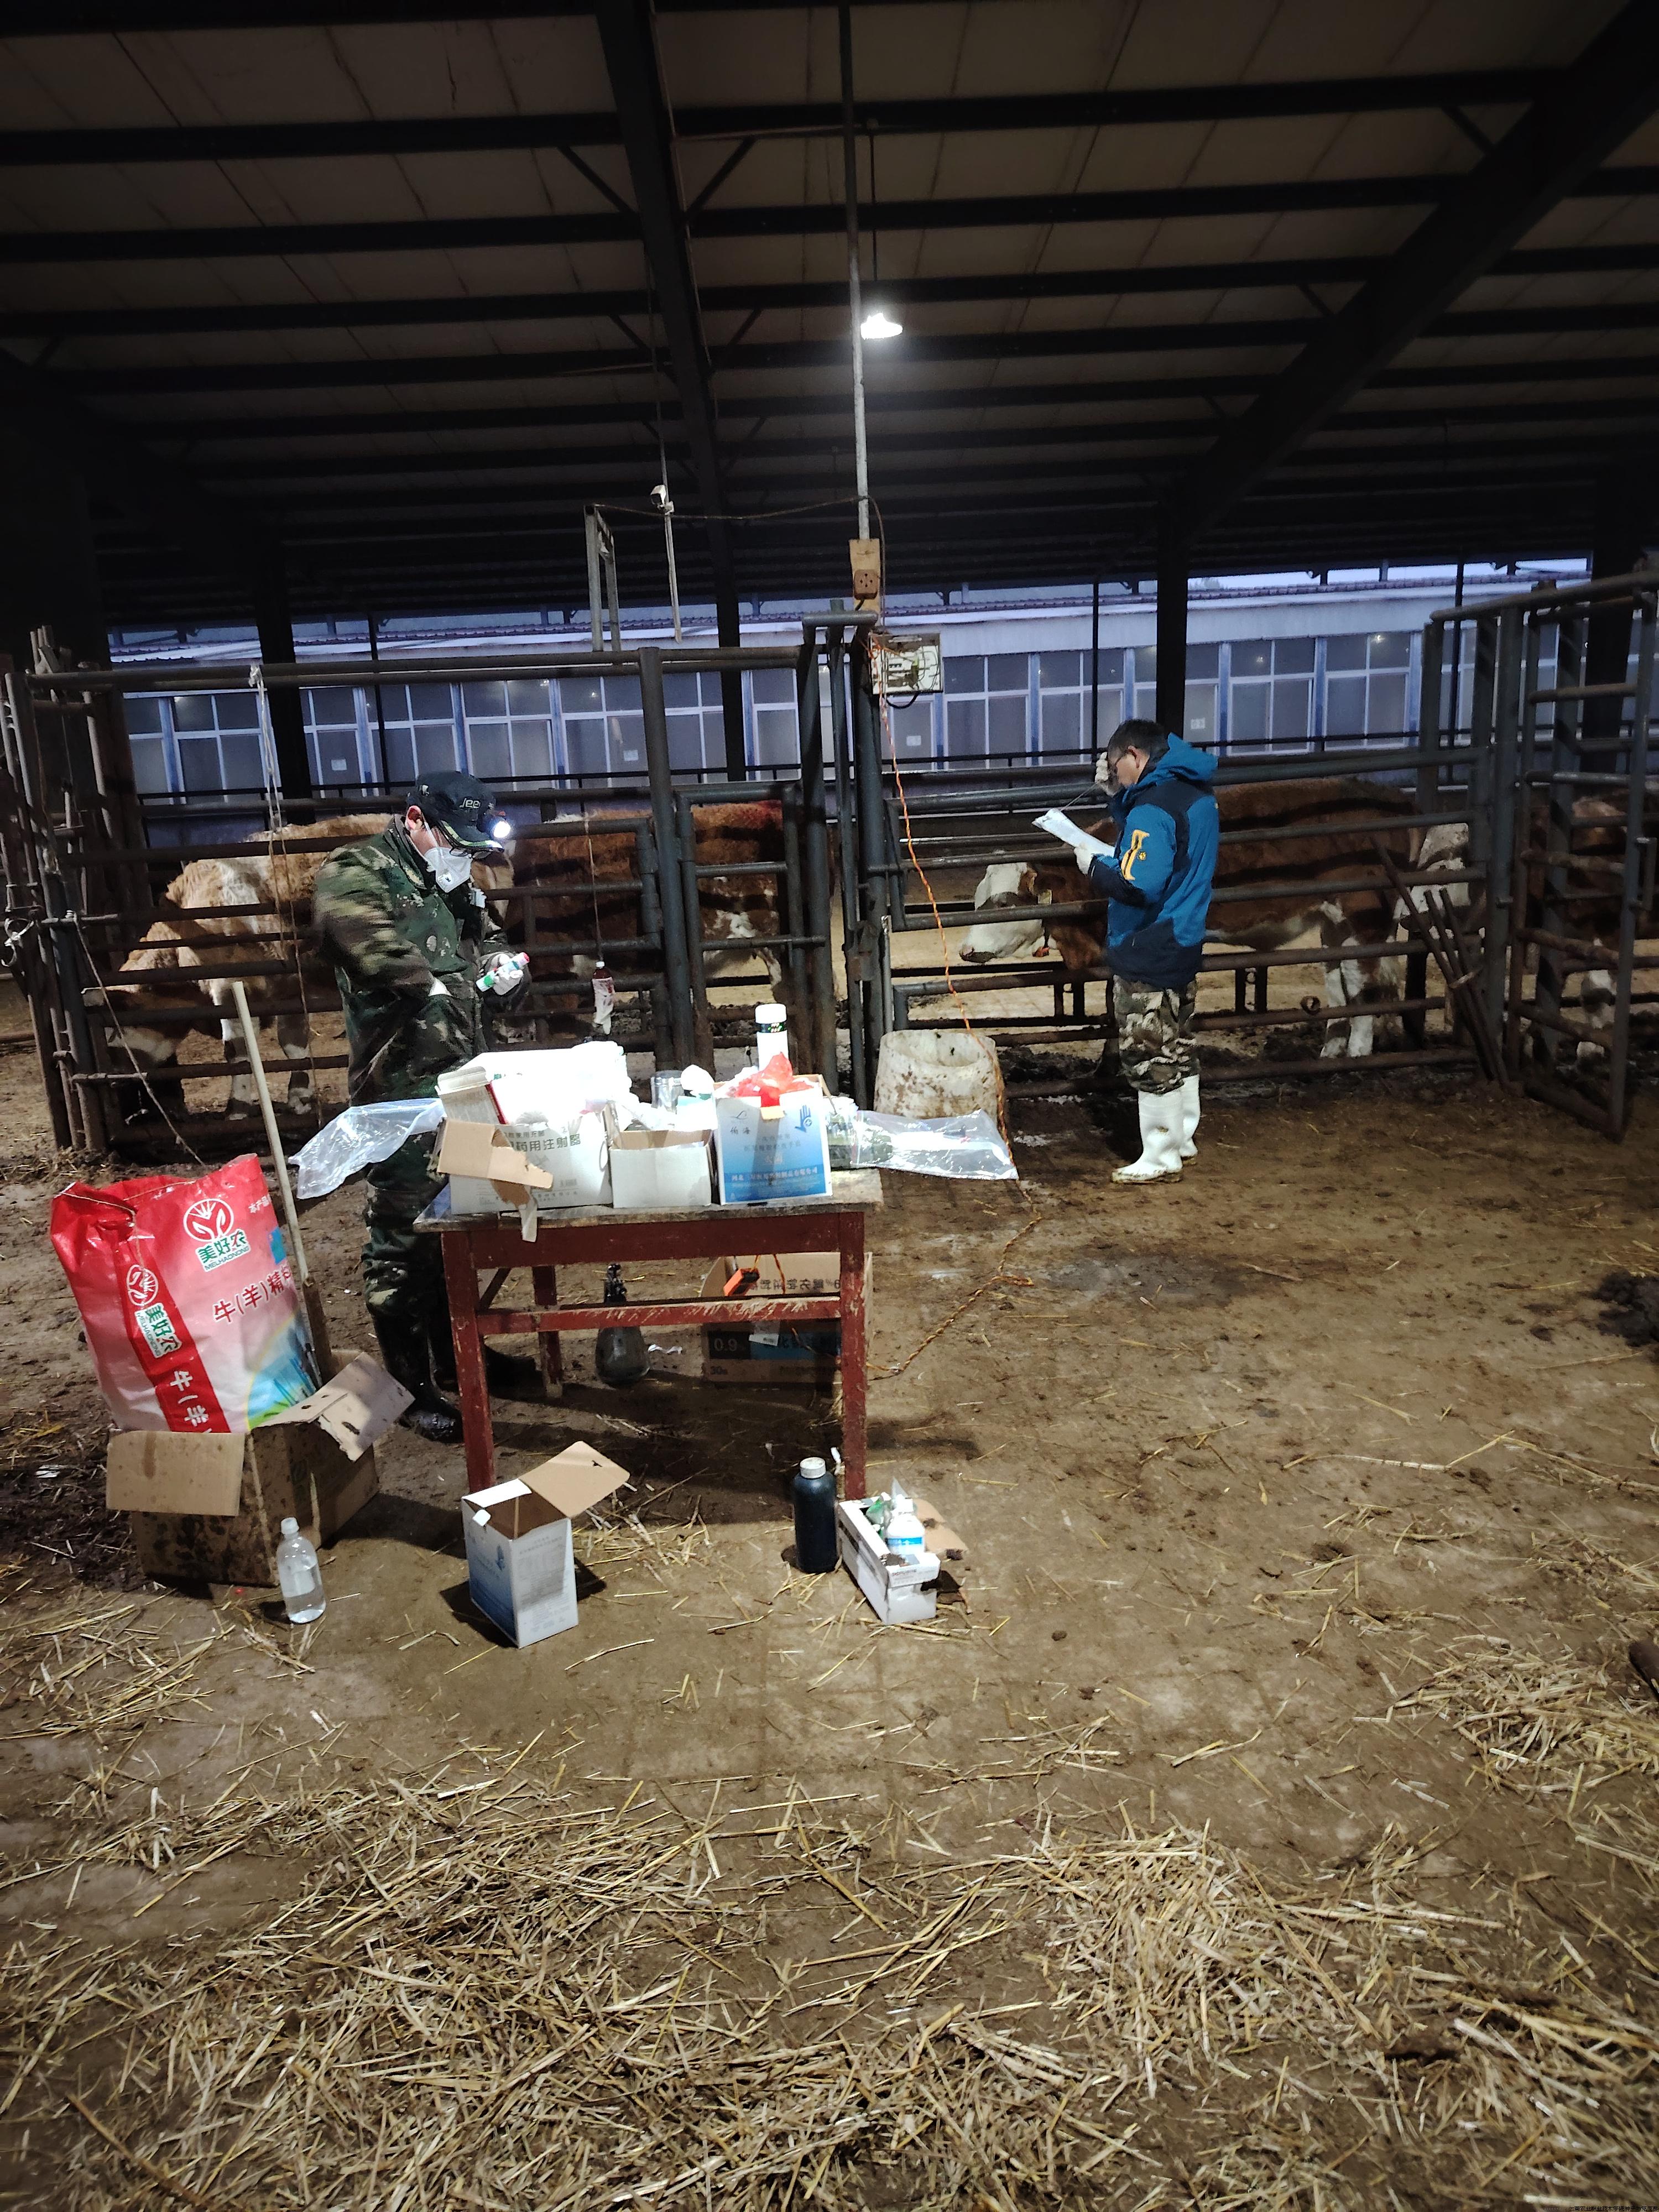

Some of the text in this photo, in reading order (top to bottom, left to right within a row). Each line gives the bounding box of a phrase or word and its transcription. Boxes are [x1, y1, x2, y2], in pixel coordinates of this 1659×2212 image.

[509, 1133, 581, 1152] 药用注射器
[197, 1230, 247, 1264] 美好农
[145, 1304, 178, 1353] 美好农
